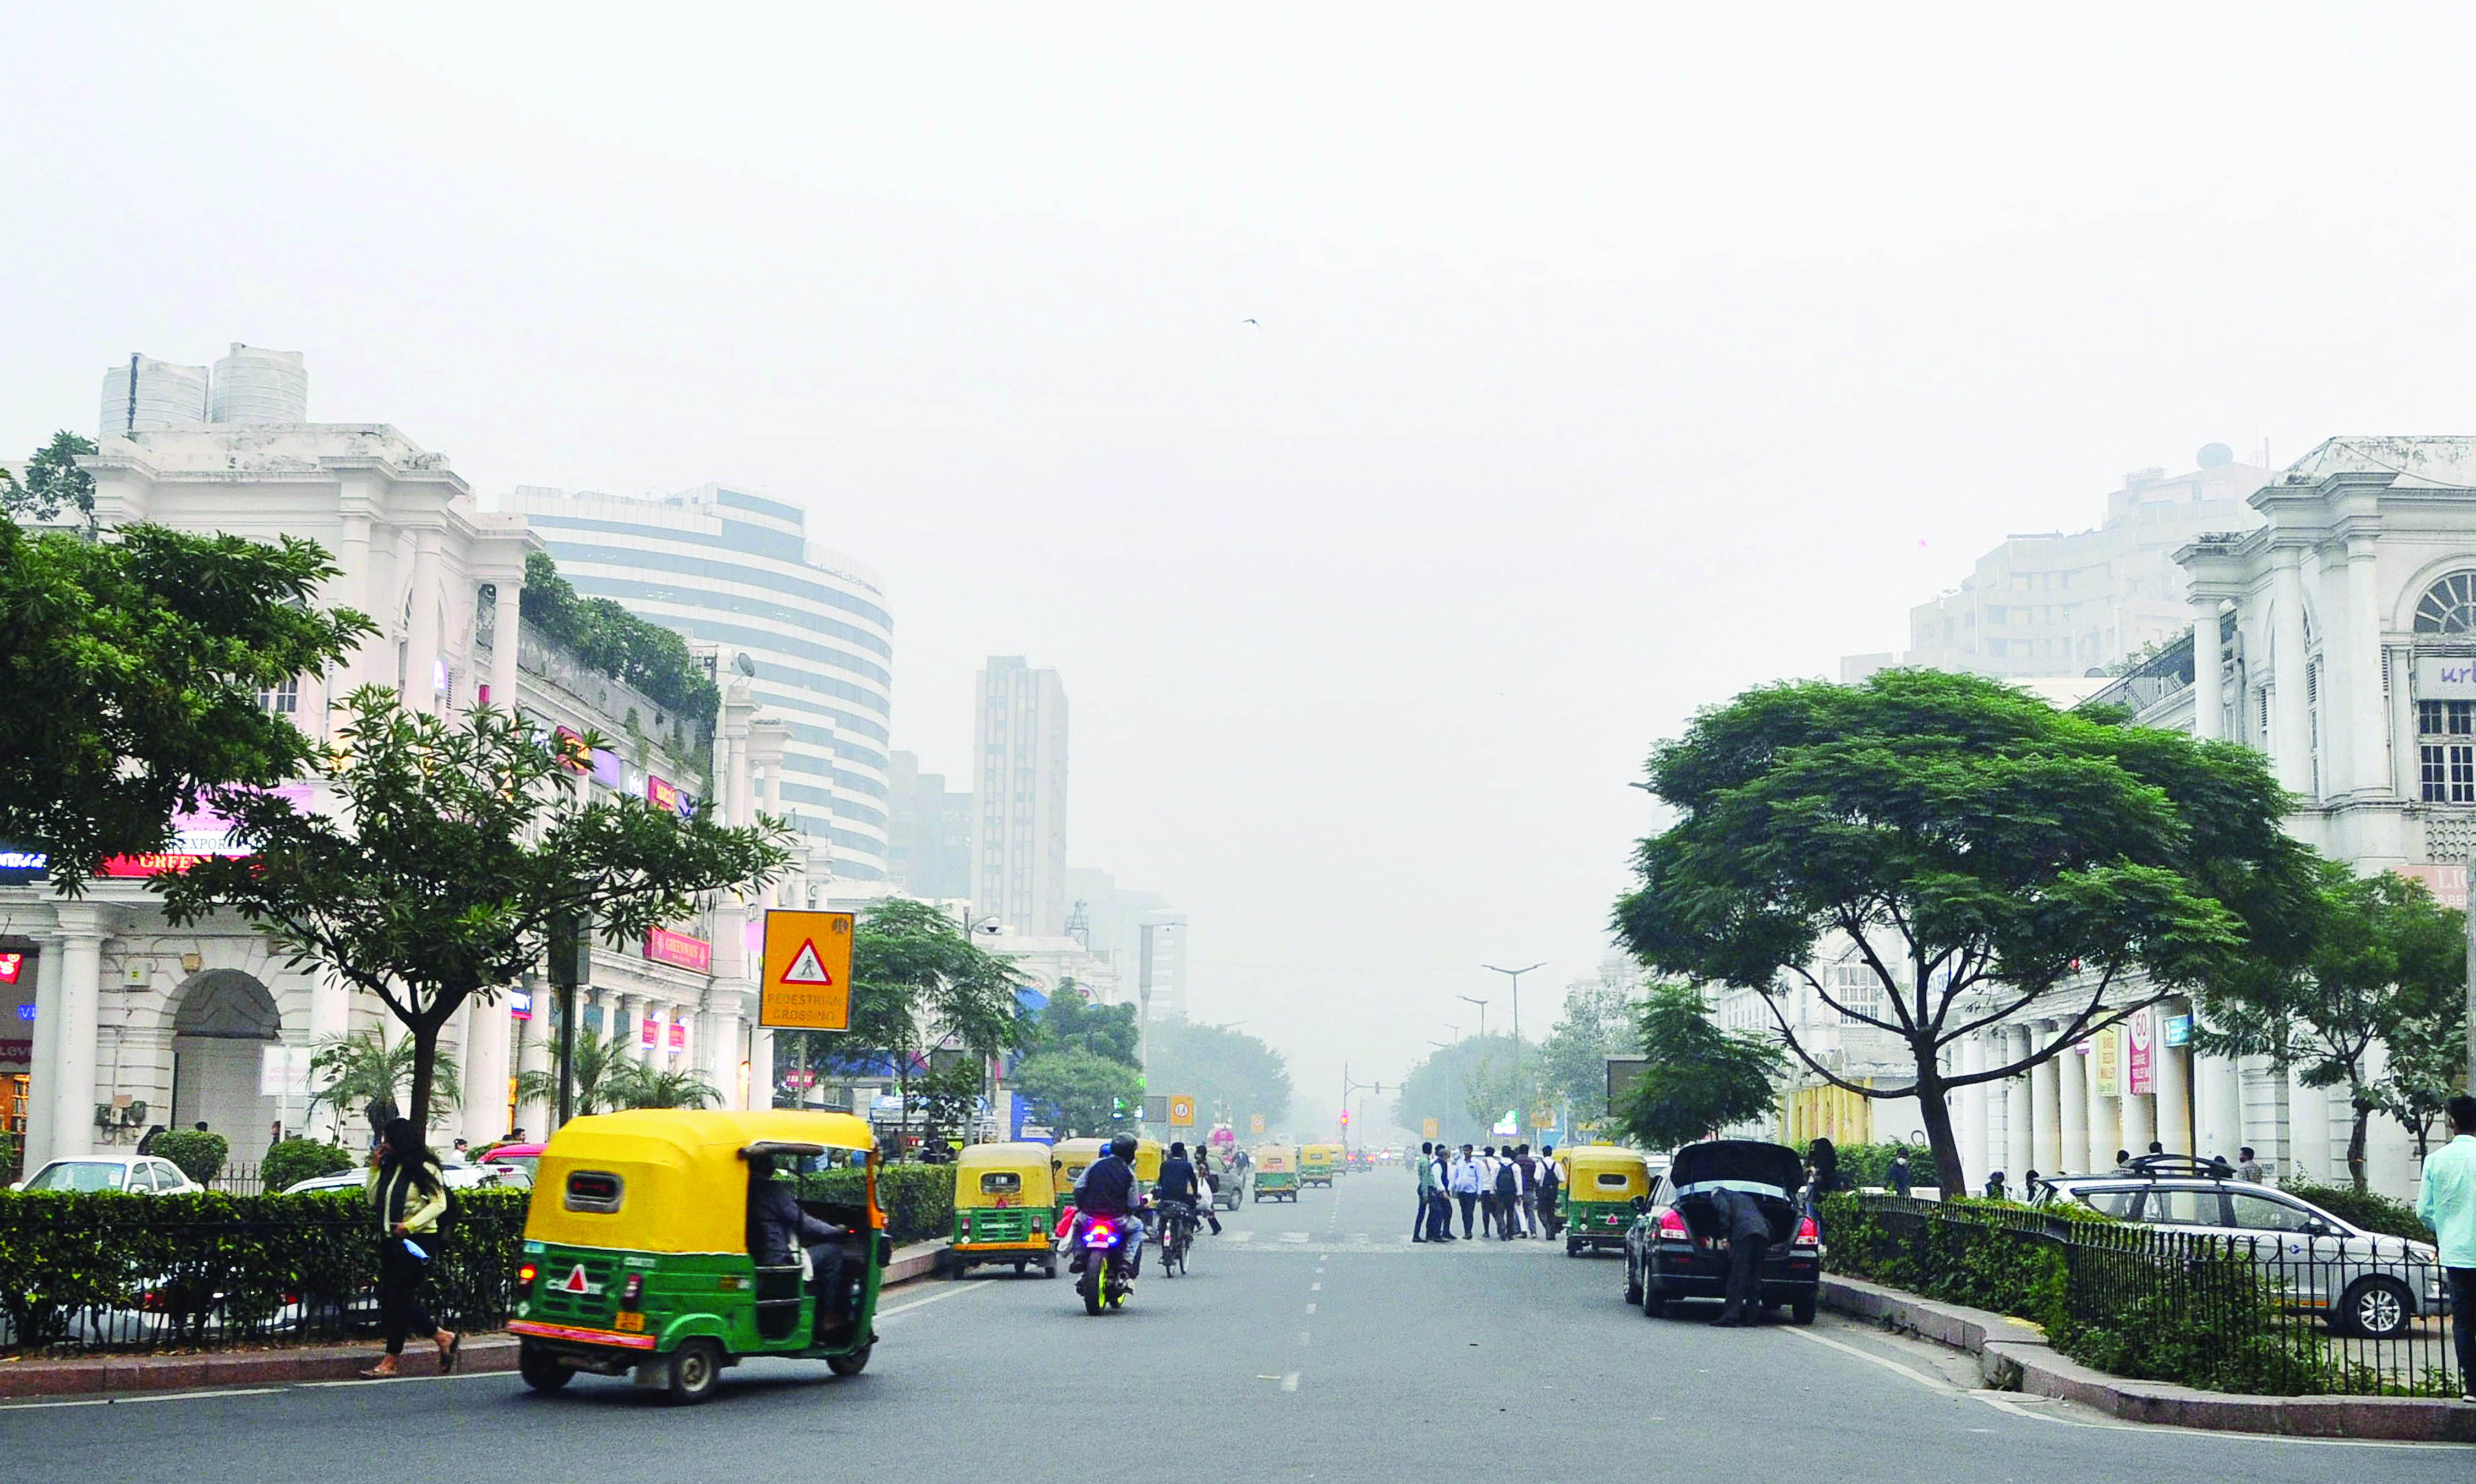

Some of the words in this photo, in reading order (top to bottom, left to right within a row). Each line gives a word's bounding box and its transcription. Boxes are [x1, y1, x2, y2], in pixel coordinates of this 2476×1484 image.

[182, 838, 233, 850] EXPOR
[767, 993, 842, 1006] PEDESTRIAN
[773, 1009, 836, 1021] CROSSING
